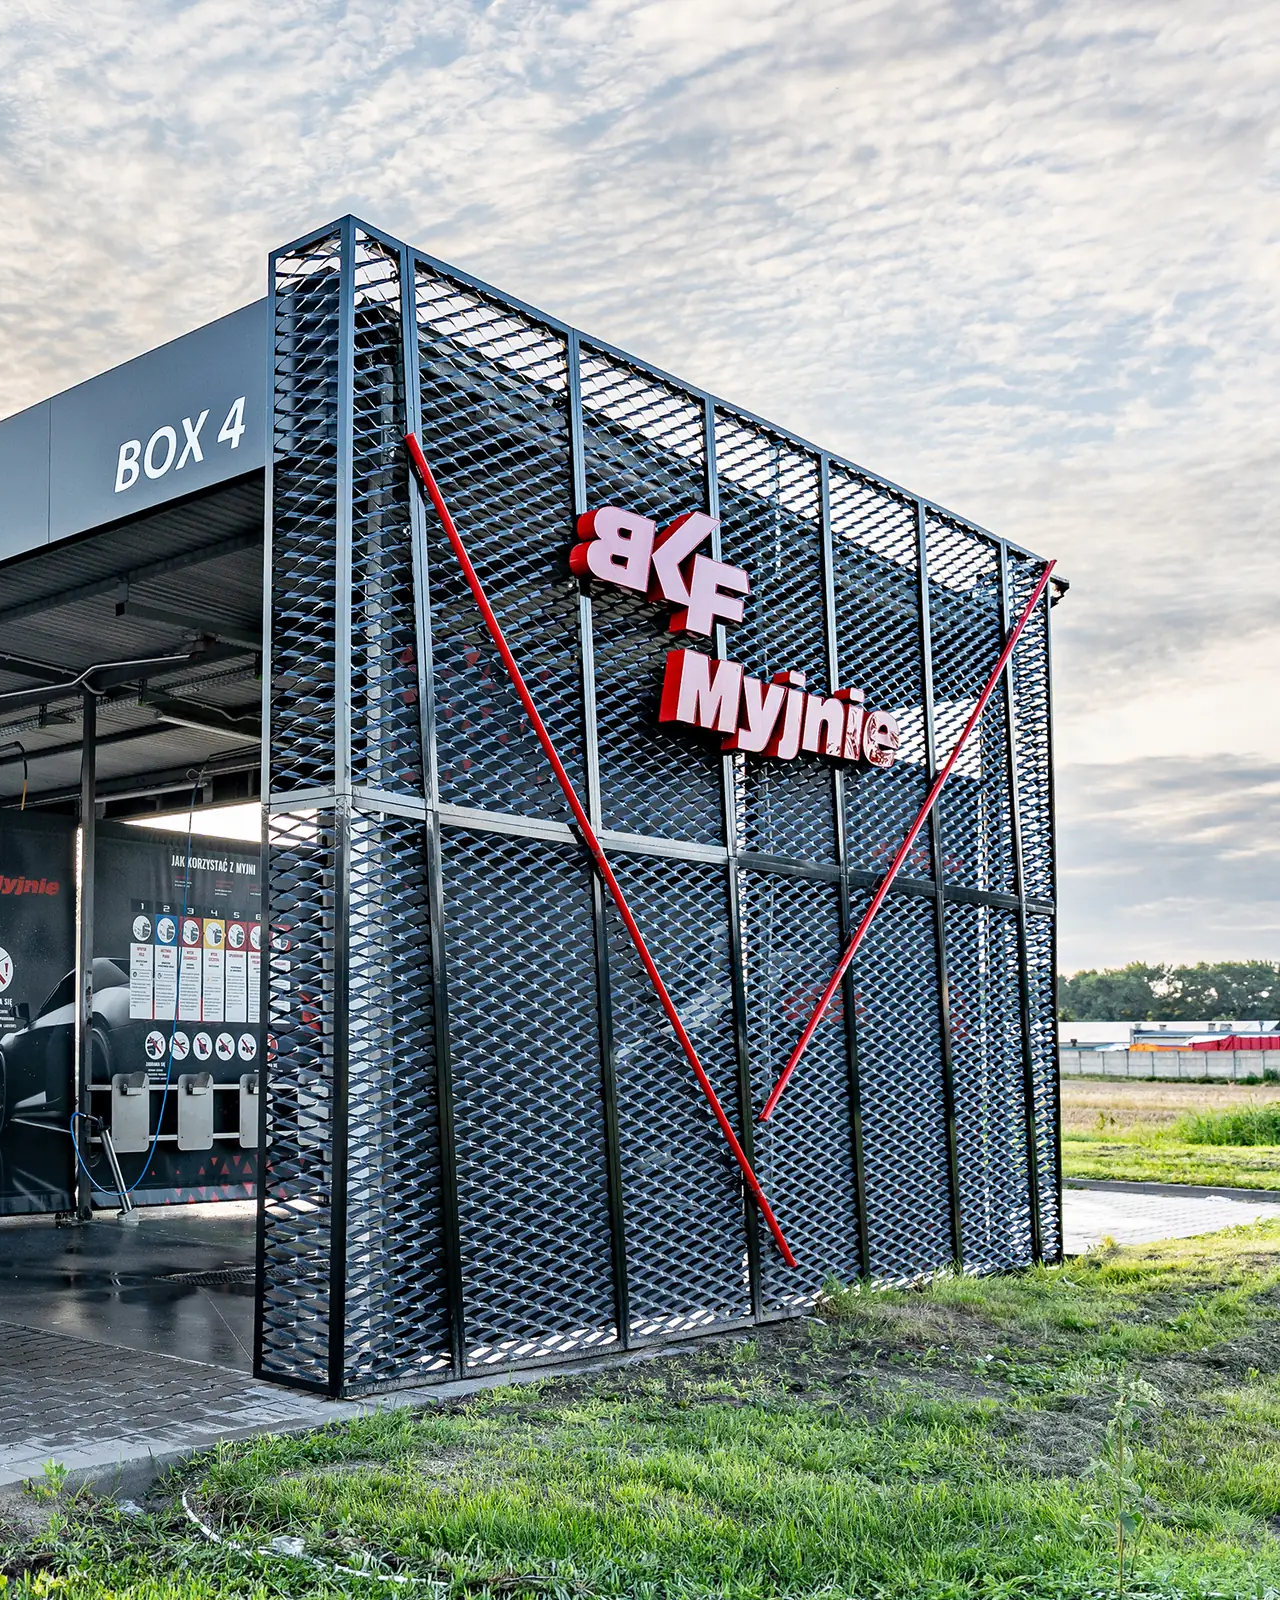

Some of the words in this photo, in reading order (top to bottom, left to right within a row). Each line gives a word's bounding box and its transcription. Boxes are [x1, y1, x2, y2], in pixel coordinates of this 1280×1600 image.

[115, 409, 210, 493] BOX
[217, 396, 246, 450] 4
[658, 649, 901, 769] Myjnie
[171, 855, 185, 868] JAK
[188, 857, 228, 873] KORZYSTAĆ
[229, 863, 234, 873] Z
[236, 862, 256, 875] MYJNI
[187, 907, 194, 915] 3
[210, 909, 218, 917] 4
[233, 911, 240, 919] 5
[4, 998, 13, 1008] SIĘ
